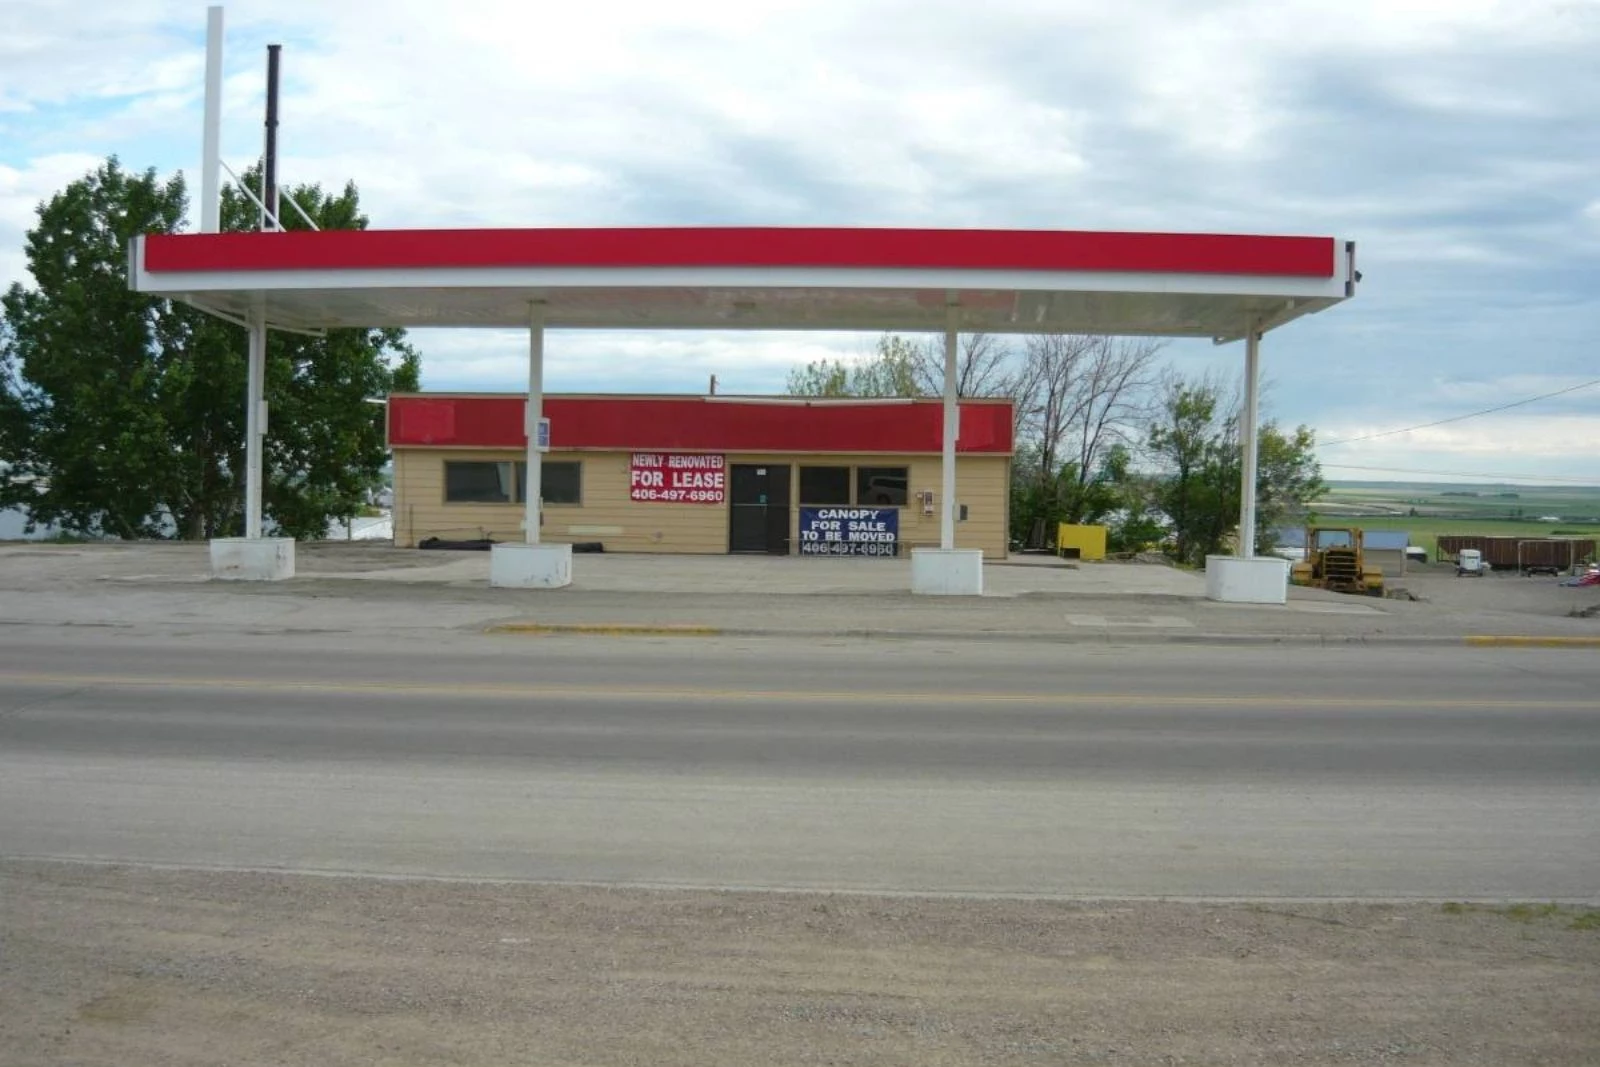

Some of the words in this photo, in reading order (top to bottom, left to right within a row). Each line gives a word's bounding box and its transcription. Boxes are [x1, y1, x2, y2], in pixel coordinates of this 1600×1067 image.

[633, 454, 663, 467] NEWLY
[668, 456, 722, 468] RENOVATED
[632, 471, 663, 486] FOR
[673, 472, 723, 487] LEASE
[632, 489, 723, 500] 406-497-6960
[818, 509, 879, 519] CANOPY
[811, 520, 841, 530] FOR
[848, 522, 886, 531] SALE
[802, 531, 818, 541] TO
[825, 531, 842, 541] BE
[849, 532, 895, 542] MOVED
